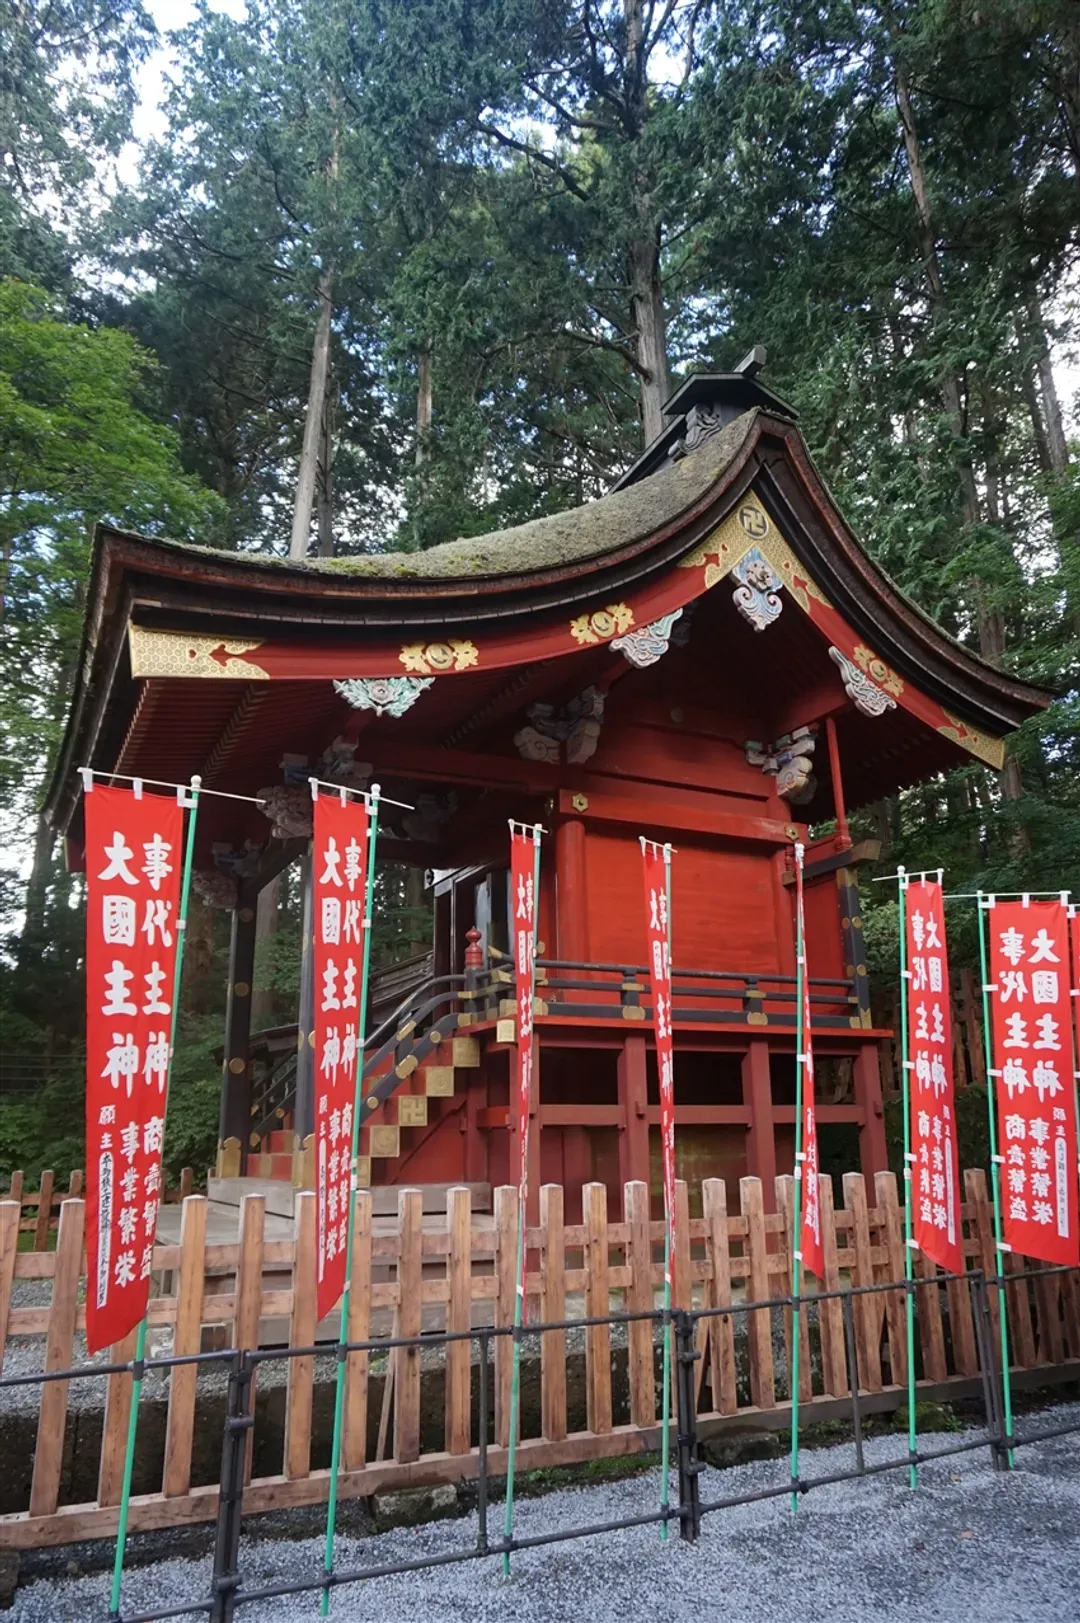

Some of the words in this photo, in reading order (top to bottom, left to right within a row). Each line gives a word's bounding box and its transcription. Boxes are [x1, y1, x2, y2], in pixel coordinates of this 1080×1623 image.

[97, 831, 140, 1098] 大國主神
[141, 833, 173, 1094] 事代主神
[319, 836, 344, 1087] 大國主神
[340, 837, 362, 1081] 事代主神
[98, 1105, 116, 1150] 願主
[115, 1121, 140, 1288] 事業繁栄
